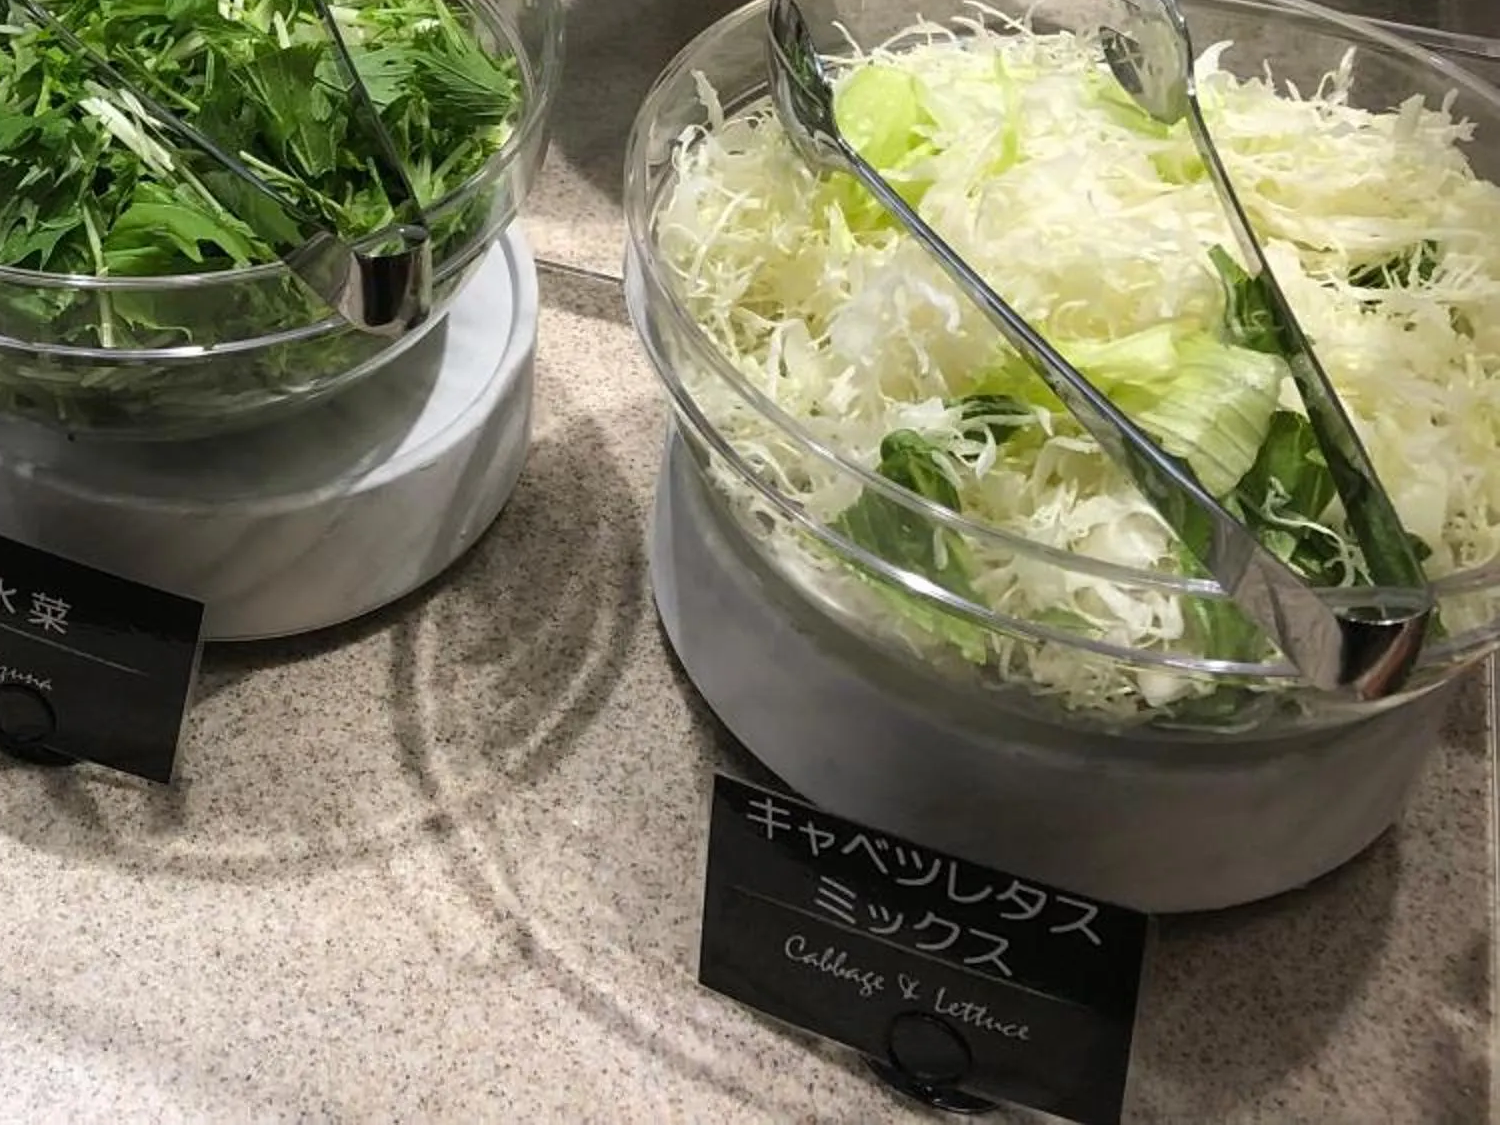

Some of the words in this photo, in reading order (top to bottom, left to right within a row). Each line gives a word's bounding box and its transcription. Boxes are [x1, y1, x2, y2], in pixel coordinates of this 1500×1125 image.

[746, 798, 1102, 946] キャベツレタス
[814, 875, 1013, 976] ミックス
[785, 936, 885, 997] Cabbage
[899, 975, 920, 1001] &
[934, 987, 1031, 1042] Lettuce
